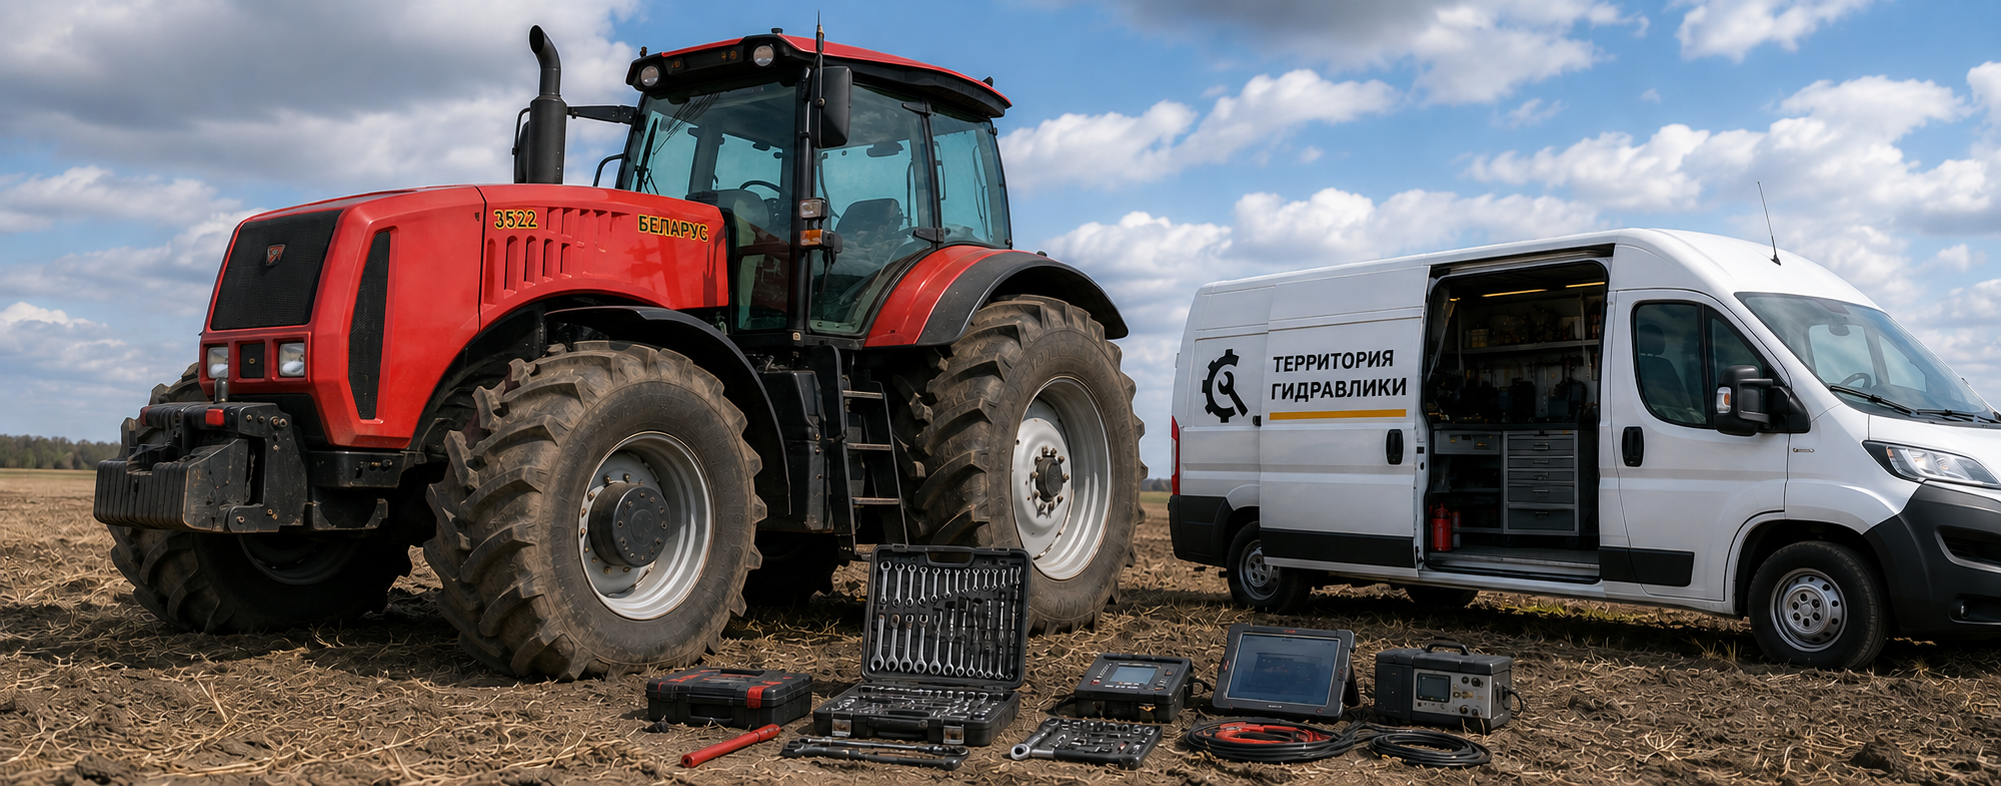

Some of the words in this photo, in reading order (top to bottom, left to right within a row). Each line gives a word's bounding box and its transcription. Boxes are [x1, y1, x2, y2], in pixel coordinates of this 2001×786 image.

[494, 209, 538, 229] 3522
[638, 214, 709, 242] БЕЛАРУС
[1272, 349, 1395, 373] ТЕРРИТОРИЯ
[1270, 377, 1408, 403] ГИДРАВЛИКИ
